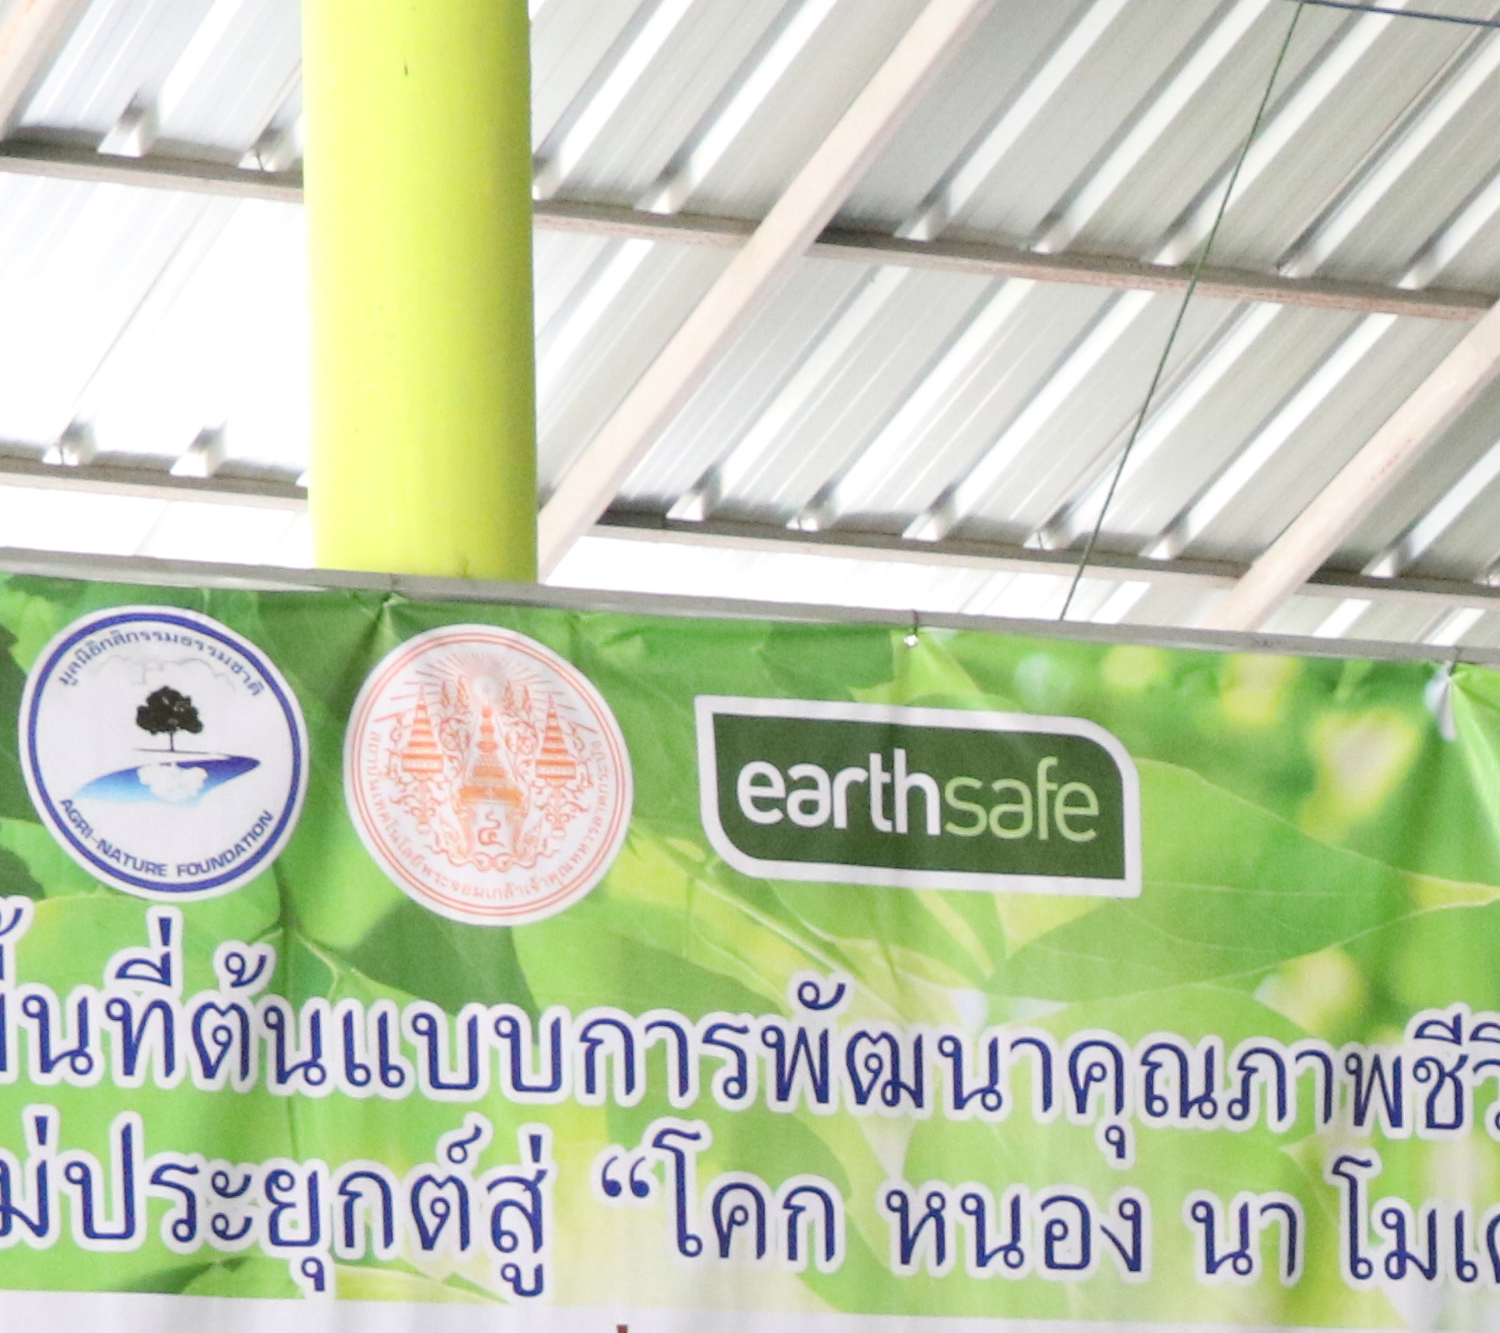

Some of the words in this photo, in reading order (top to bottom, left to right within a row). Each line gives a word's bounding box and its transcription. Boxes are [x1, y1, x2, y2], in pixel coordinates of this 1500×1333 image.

[59, 797, 169, 878] AGRI-NATURE
[176, 808, 275, 878] FOUNDATION
[736, 747, 1100, 842] earthsafe
[885, 1189, 1143, 1273] หนอง
[1191, 1199, 1297, 1276] นา
